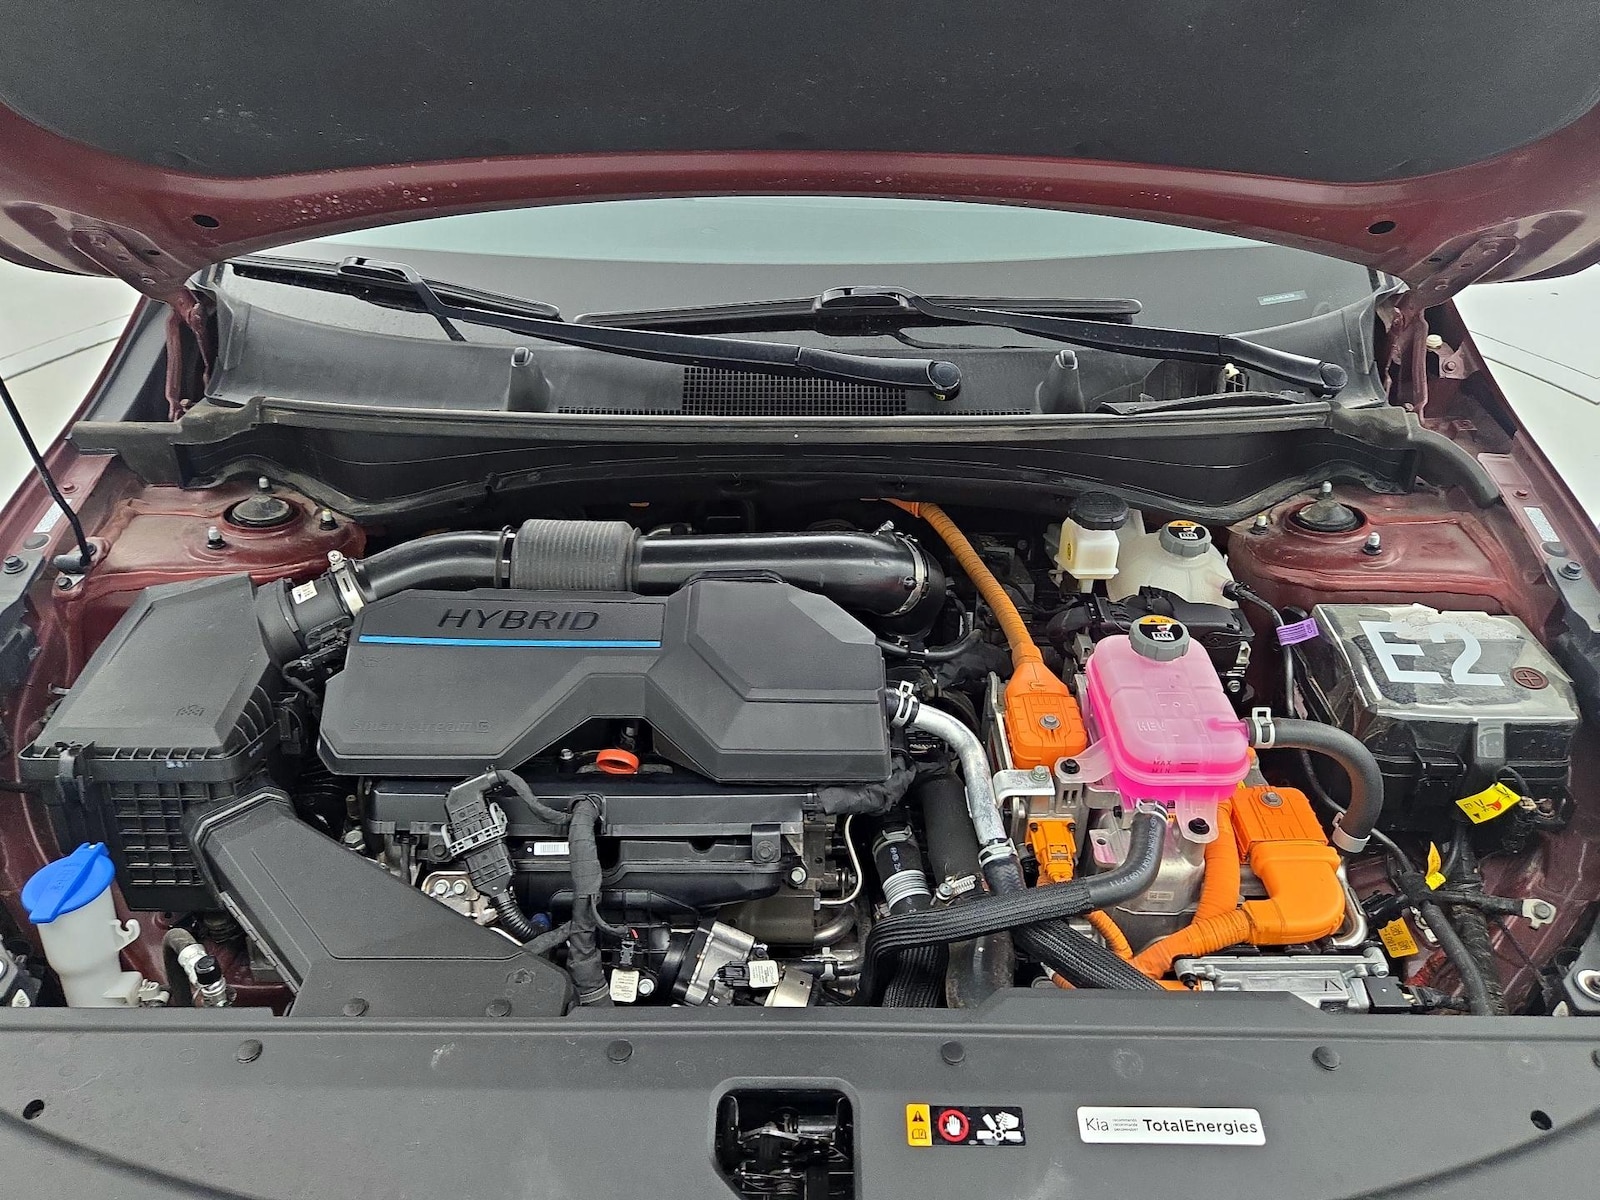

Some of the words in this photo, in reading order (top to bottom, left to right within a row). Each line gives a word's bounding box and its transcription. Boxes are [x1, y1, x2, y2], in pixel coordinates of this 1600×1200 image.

[437, 608, 600, 631] HYBRID
[1358, 620, 1505, 687] E2
[1085, 1117, 1110, 1132] Kia
[1142, 1119, 1258, 1136] TotalEnergies
